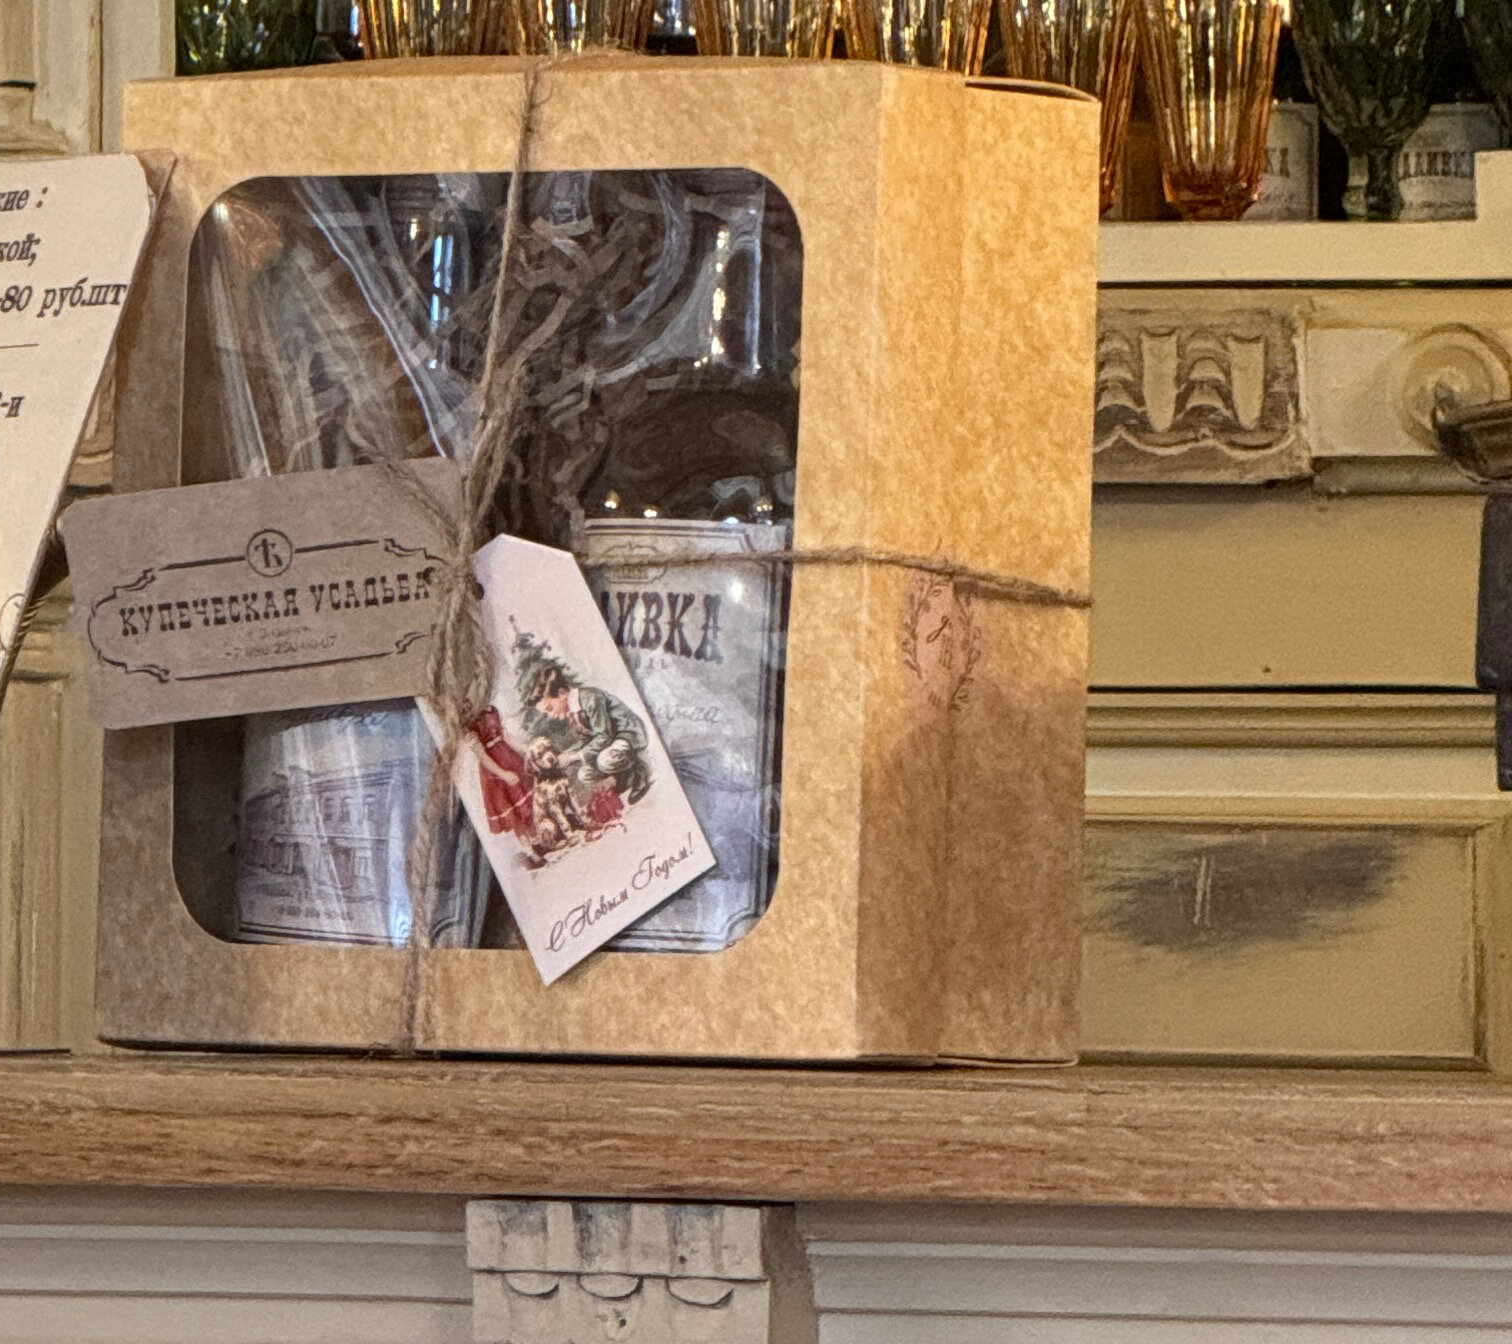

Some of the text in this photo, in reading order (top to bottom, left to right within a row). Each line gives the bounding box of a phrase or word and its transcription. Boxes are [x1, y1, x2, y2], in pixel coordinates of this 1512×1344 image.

[119, 571, 431, 638] КУПЕЧЕСКАЯ УСАДЬБА
[601, 592, 724, 664] ИВКА
[564, 888, 630, 938] Новым
[631, 831, 695, 891] Годом!
